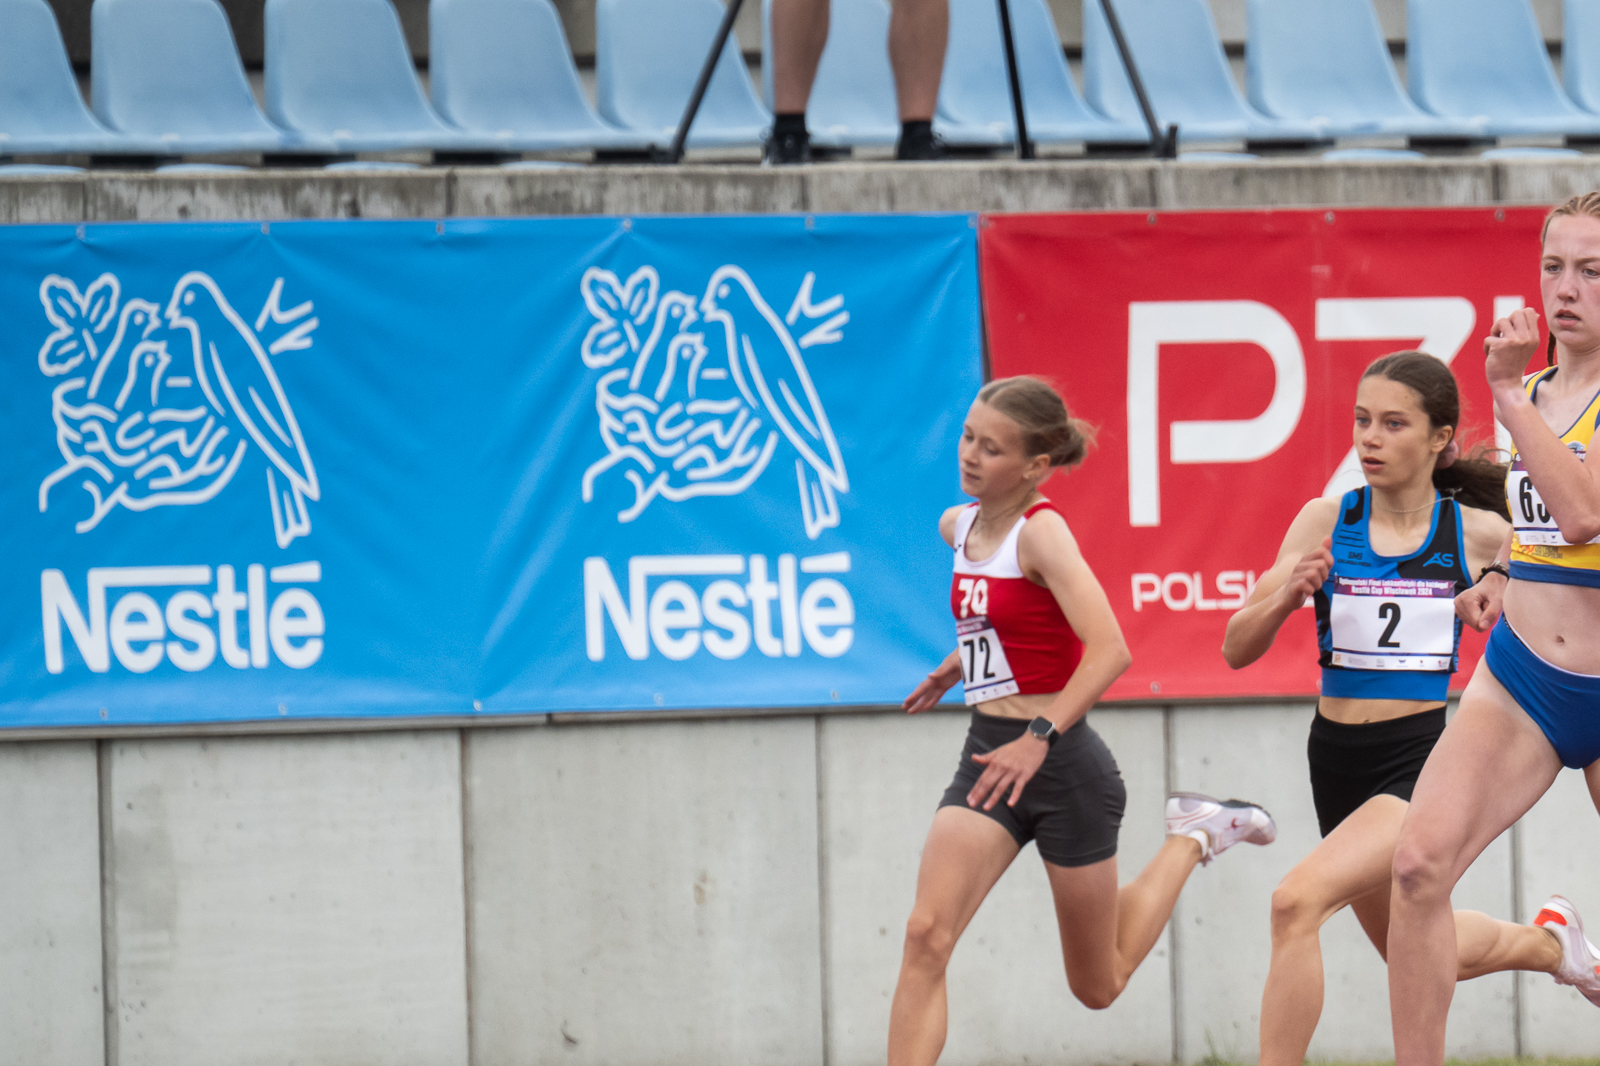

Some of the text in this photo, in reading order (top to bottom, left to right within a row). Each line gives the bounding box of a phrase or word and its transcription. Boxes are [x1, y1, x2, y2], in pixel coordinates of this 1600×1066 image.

[41, 561, 326, 674] Nestlé
[583, 551, 855, 662] Nestlé
[1378, 602, 1401, 648] 2
